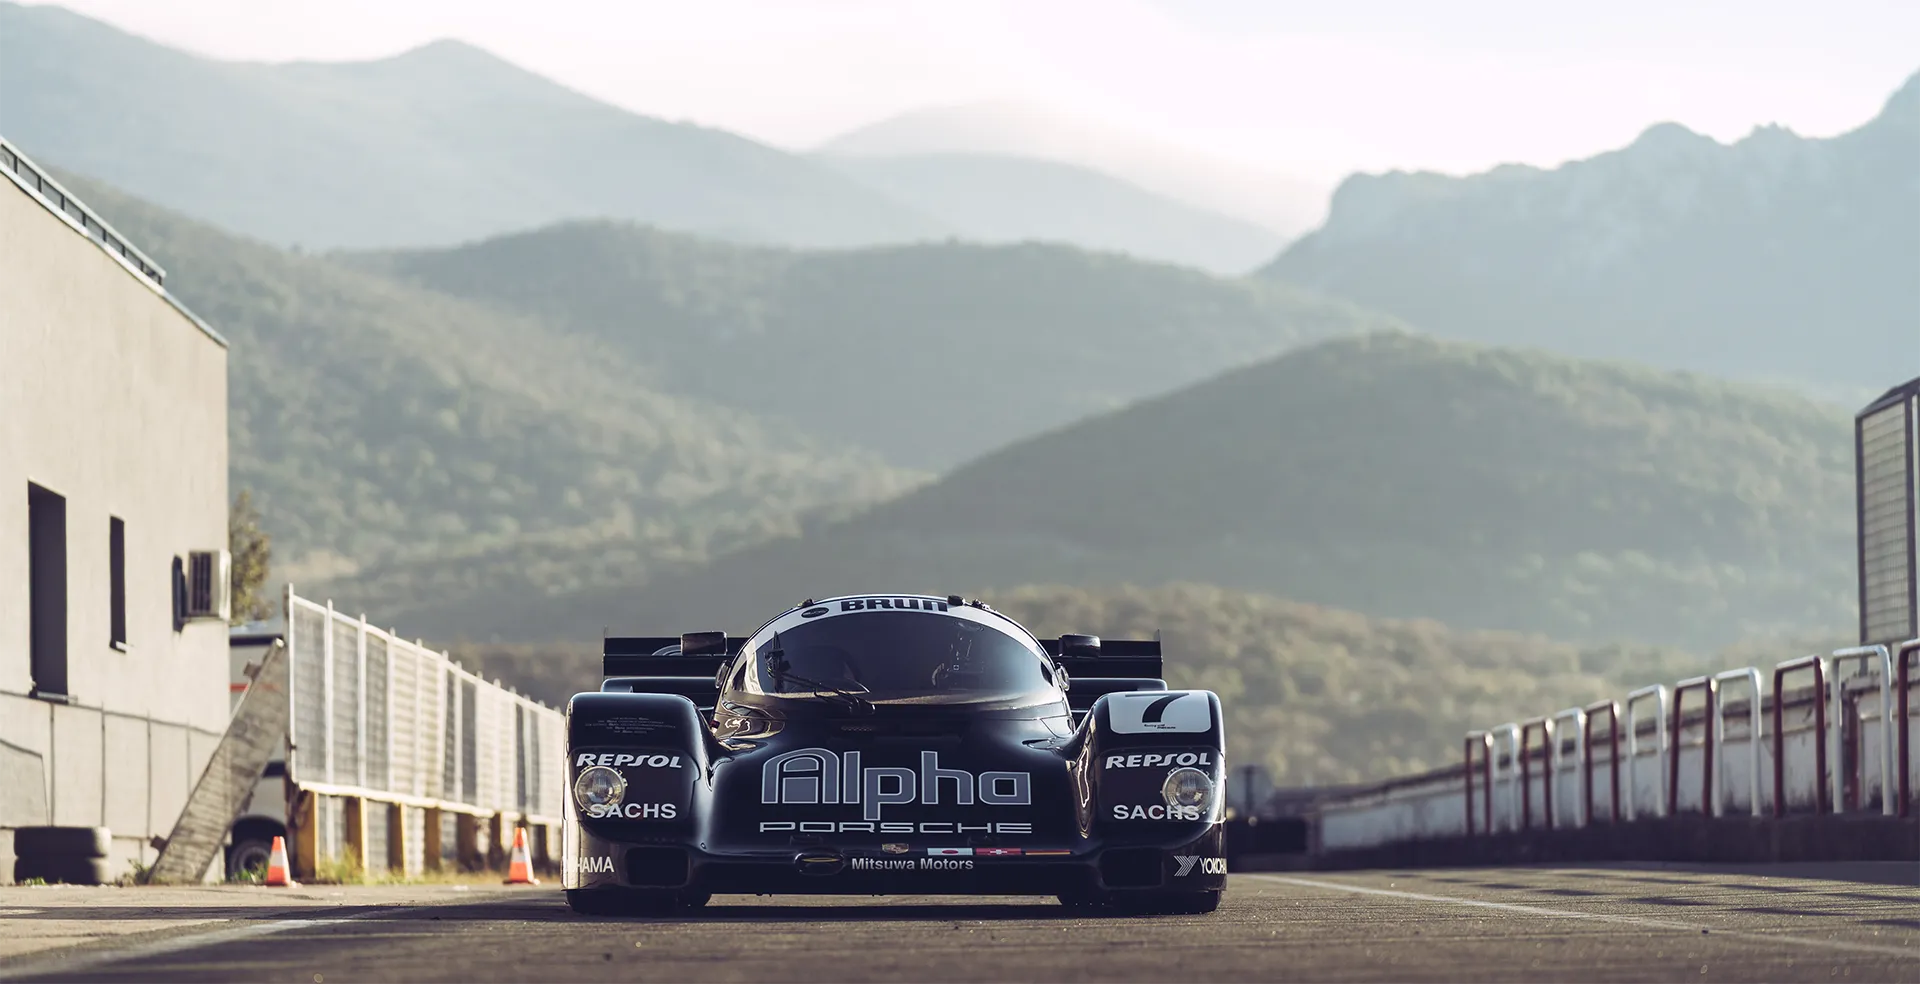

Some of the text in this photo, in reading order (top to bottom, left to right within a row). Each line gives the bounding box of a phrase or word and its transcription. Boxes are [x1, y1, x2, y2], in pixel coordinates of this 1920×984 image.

[1125, 692, 1190, 723] 7
[576, 753, 682, 768] REPSOL
[1105, 752, 1212, 770] REPSOL
[761, 747, 1031, 821] Alpha
[590, 803, 677, 819] SACHS
[1113, 804, 1200, 821] SACHS
[759, 821, 1032, 834] PORSCHE
[851, 857, 974, 870] Mitsuwa Motors
